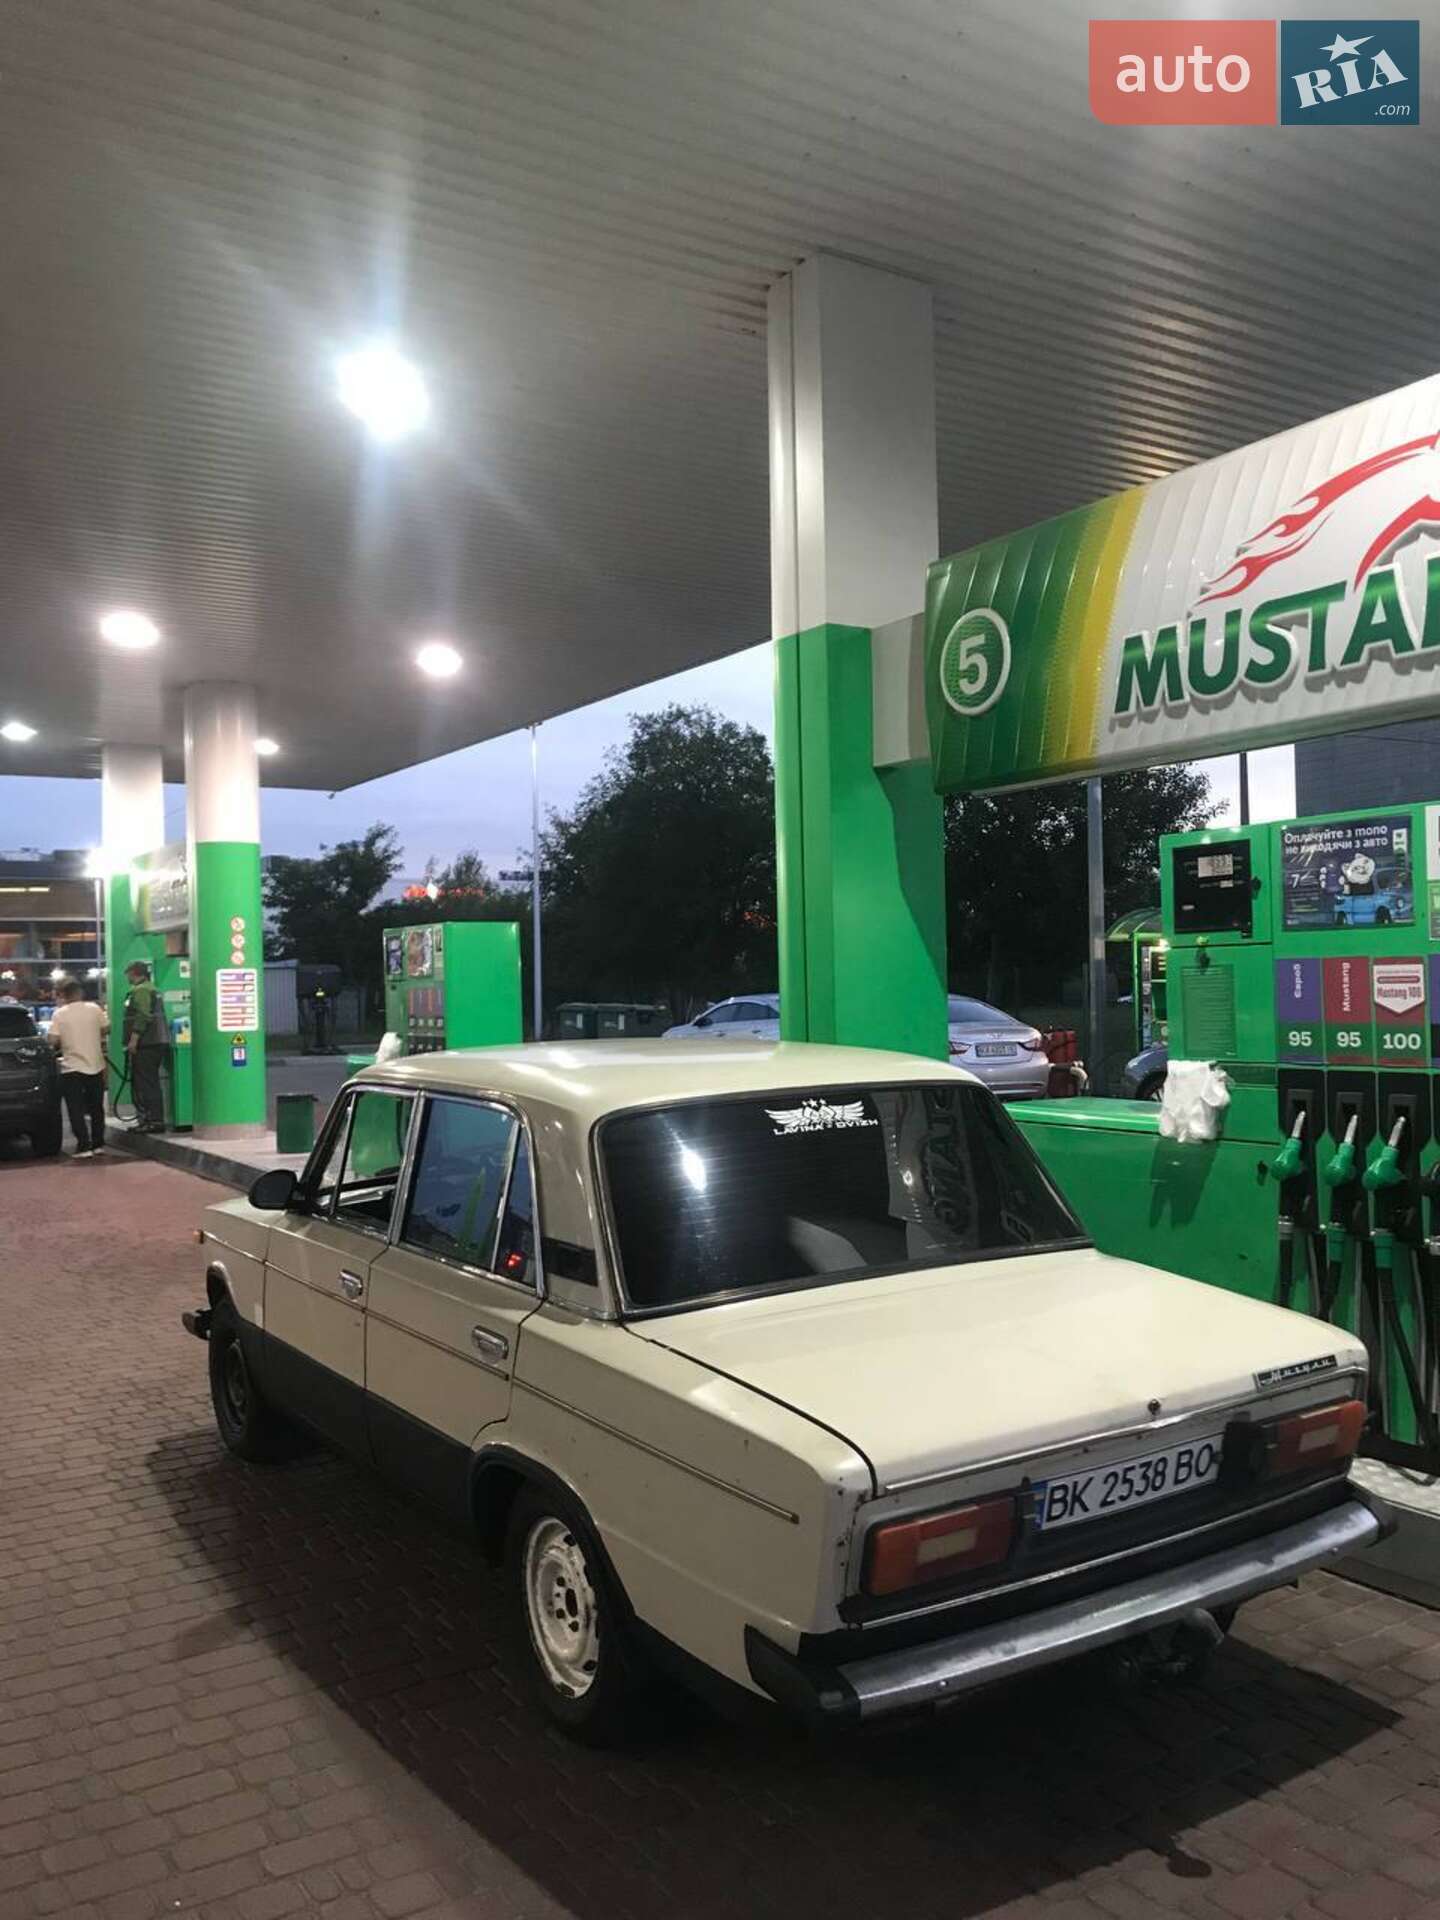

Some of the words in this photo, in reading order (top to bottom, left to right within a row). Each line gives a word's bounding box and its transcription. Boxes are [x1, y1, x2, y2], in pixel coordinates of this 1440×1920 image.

[957, 633, 989, 696] 5
[1288, 1031, 1313, 1047] 95
[1336, 1031, 1362, 1047] 95
[1383, 1033, 1422, 1050] 100
[1046, 1476, 1095, 1522] BK
[1099, 1456, 1169, 1509] 2538
[1173, 1443, 1214, 1486] BO
